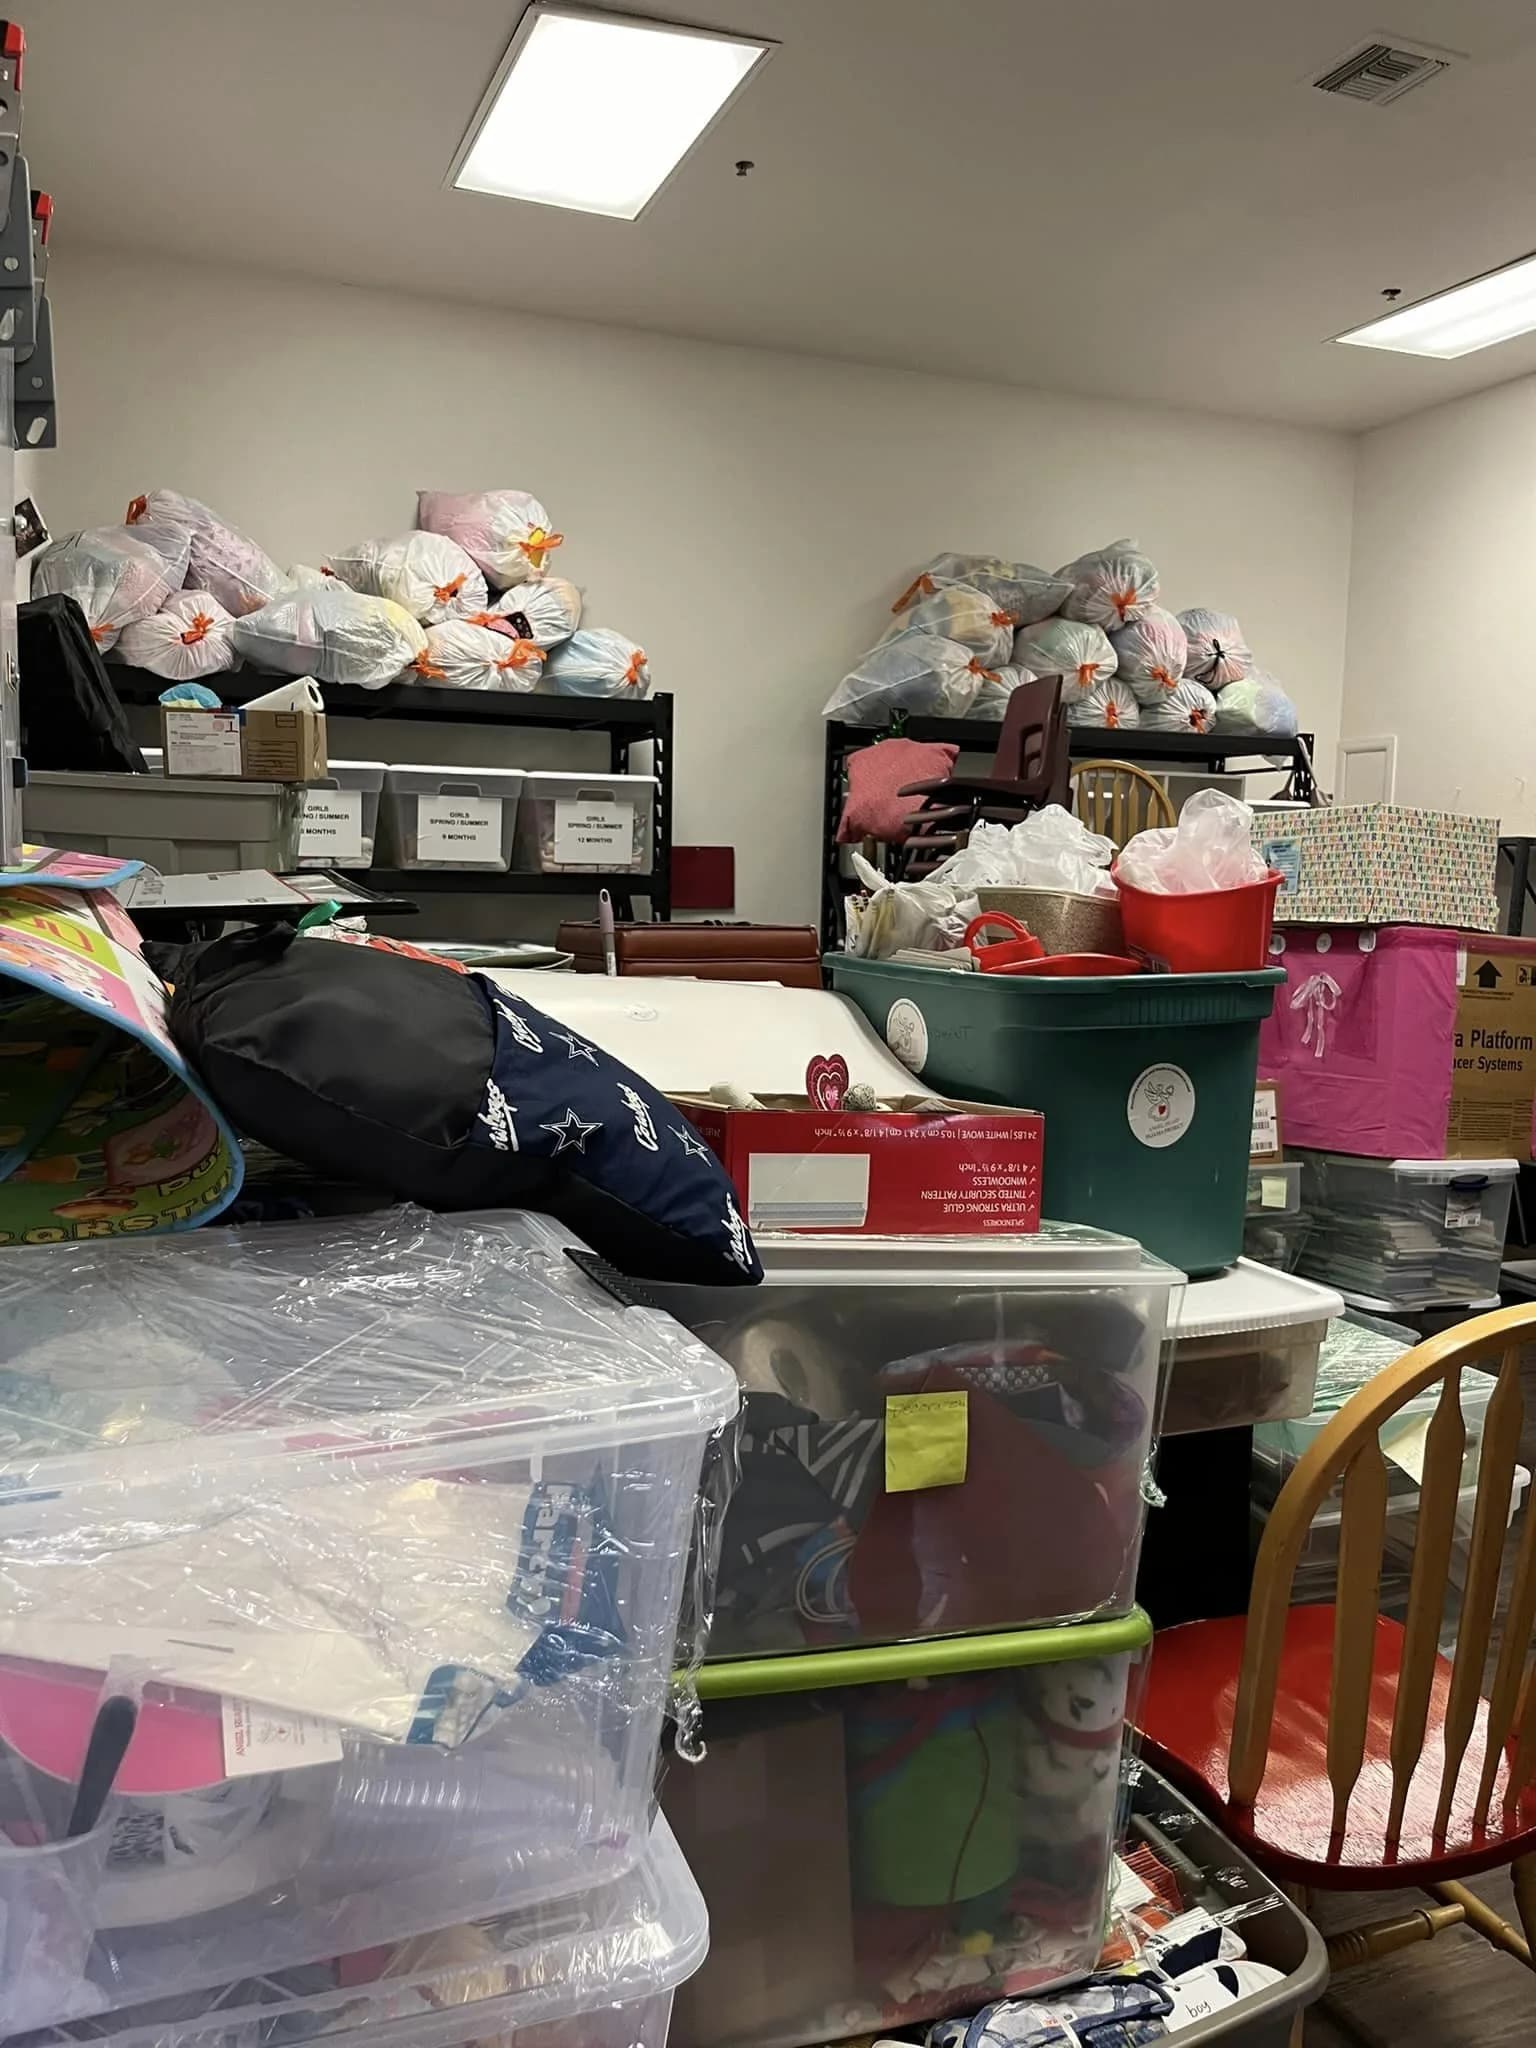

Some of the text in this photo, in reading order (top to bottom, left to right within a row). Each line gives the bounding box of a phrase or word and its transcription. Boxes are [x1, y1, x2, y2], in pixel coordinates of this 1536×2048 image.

[430, 818, 456, 826] SPRING
[447, 833, 477, 841] MONTHS
[1470, 1028, 1533, 1051] Platform
[1477, 1055, 1524, 1074] Systems
[961, 1130, 984, 1139] WOVE
[984, 1130, 1009, 1139] WHITE
[1014, 1130, 1031, 1139] LBS
[1031, 1130, 1038, 1139] 24
[959, 1163, 976, 1173] Inch
[972, 1176, 1027, 1186] WINDOWLESS
[921, 1190, 1027, 1199] TINTED SECURITY PATTERN
[943, 1203, 1026, 1213] ULTRA STRONG GLUE
[1184, 2001, 1212, 2018] boy
